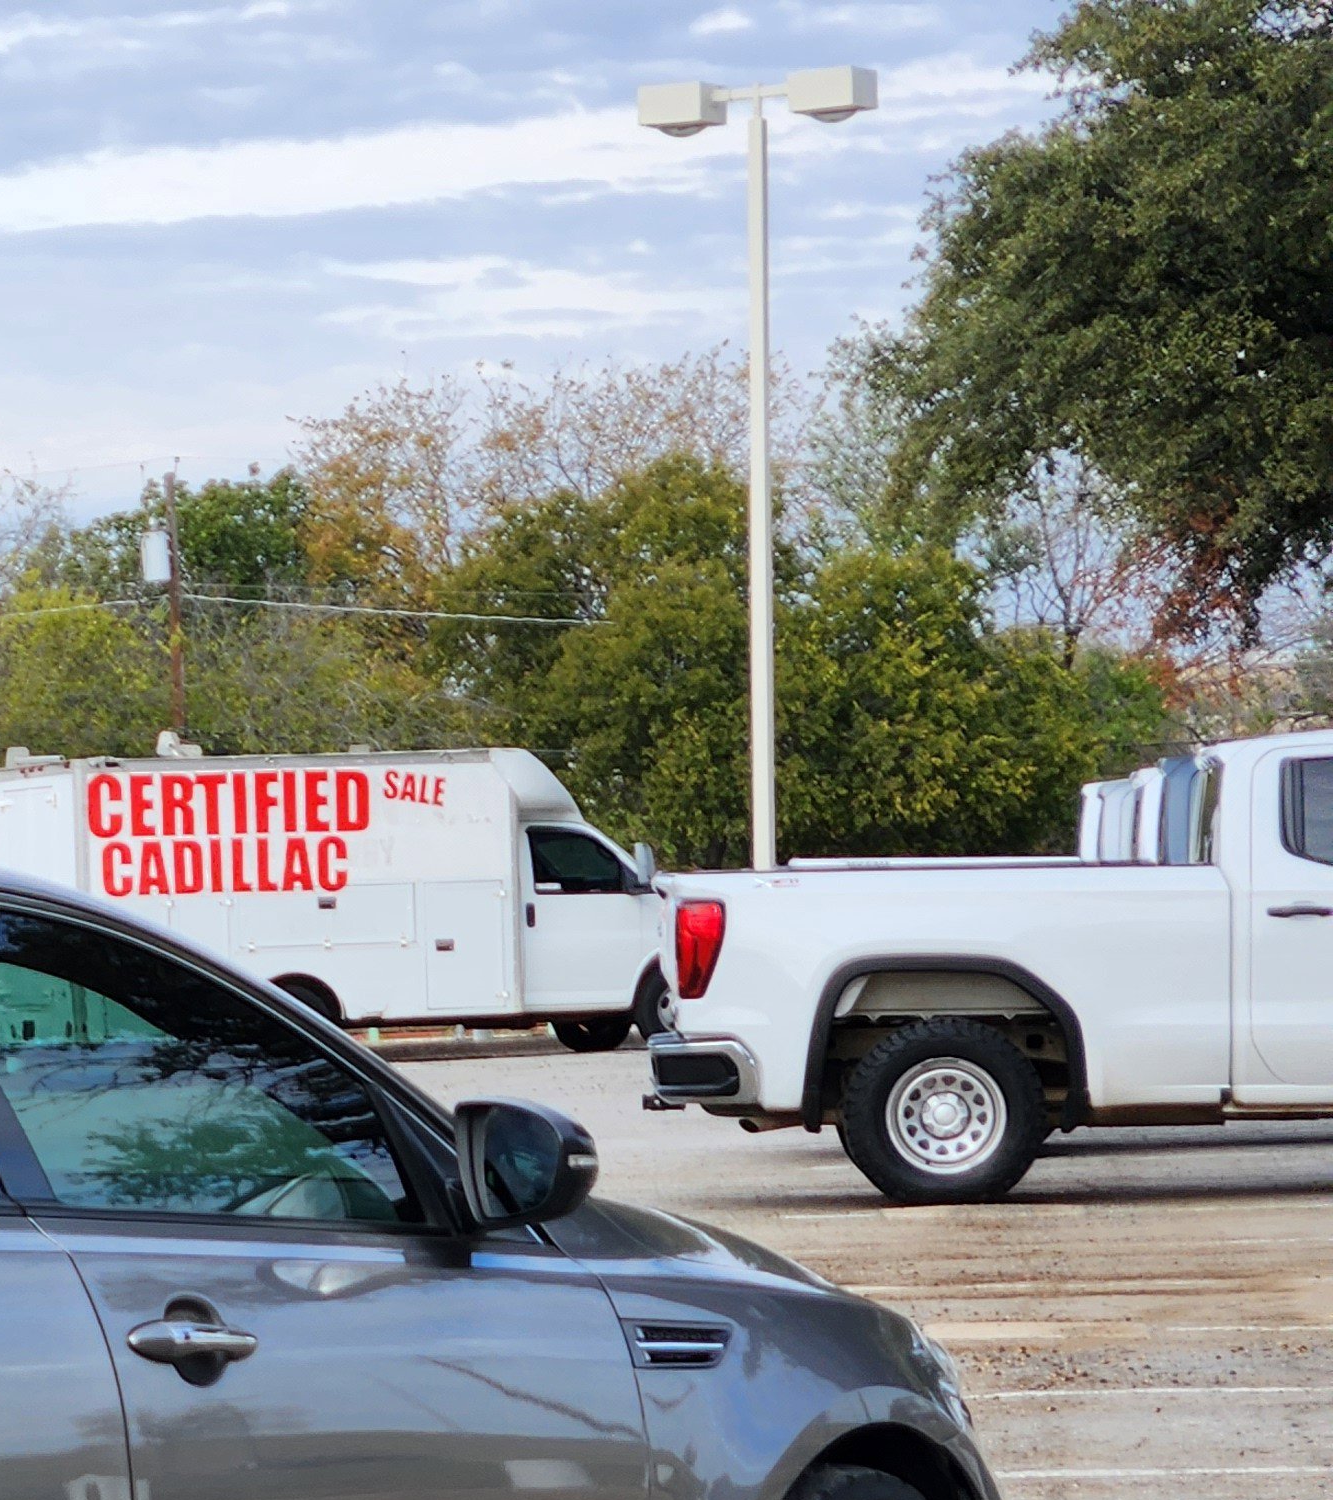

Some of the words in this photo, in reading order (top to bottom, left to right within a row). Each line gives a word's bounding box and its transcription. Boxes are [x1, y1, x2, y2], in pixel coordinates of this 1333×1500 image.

[87, 769, 370, 838] CERTIFIED
[384, 769, 446, 807] SALE
[102, 837, 349, 896] CADILLAC
